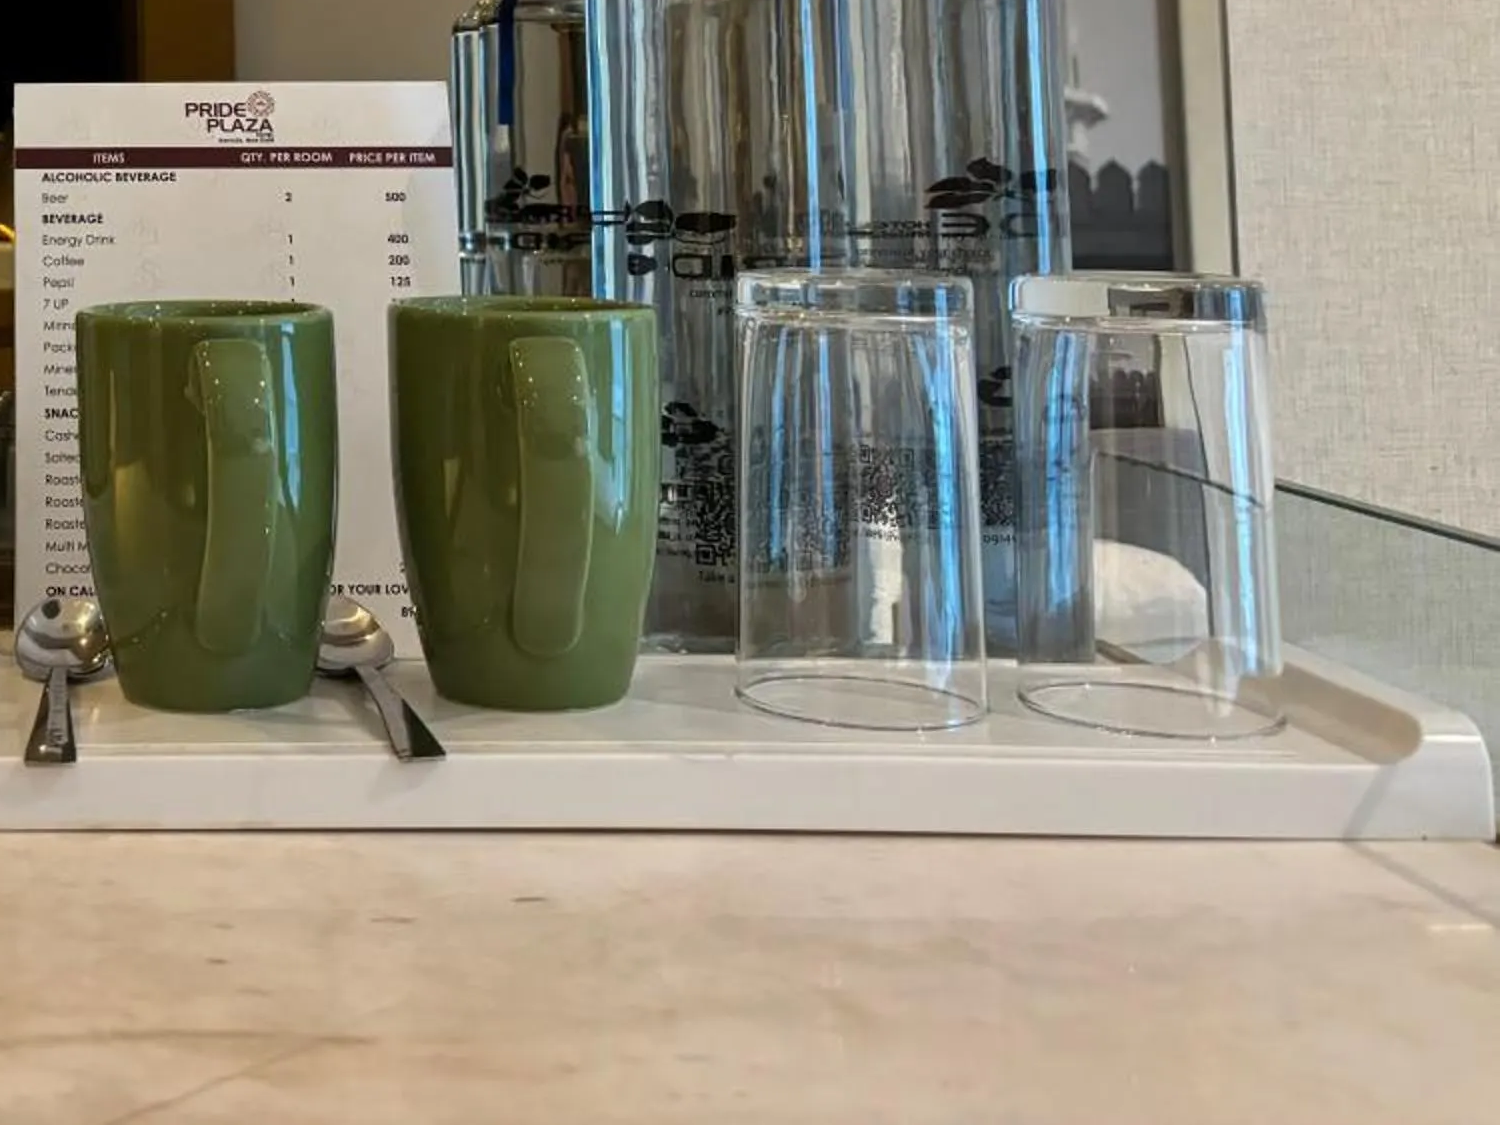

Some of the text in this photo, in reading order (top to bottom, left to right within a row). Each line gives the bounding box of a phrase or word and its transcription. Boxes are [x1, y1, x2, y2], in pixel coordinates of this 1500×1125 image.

[185, 102, 246, 117] PRIDE
[206, 118, 273, 133] PLAZA
[93, 152, 125, 164] ITEMS
[270, 152, 291, 163] PER
[294, 152, 333, 163] ROOM
[349, 152, 436, 163] PRICE PER ITEM
[41, 171, 177, 182] ALCOHOLIC BEVERAGE
[42, 192, 69, 204] Beer
[284, 192, 292, 202] 2
[385, 192, 406, 202] 500
[42, 214, 103, 224] BEVERAGE
[42, 234, 115, 247] Energy Drink
[387, 234, 408, 244] 400
[42, 255, 85, 267] Coffee
[388, 255, 410, 265] 200
[43, 276, 75, 289] Pepsi
[43, 298, 69, 310] 7 UP
[44, 408, 80, 419] SNAC
[45, 496, 85, 508] Roaste
[45, 518, 86, 530] Roaste
[45, 541, 75, 552] Multi
[45, 586, 95, 597] ON CAL
[347, 584, 381, 595] YOUR
[385, 584, 409, 595] LOV
